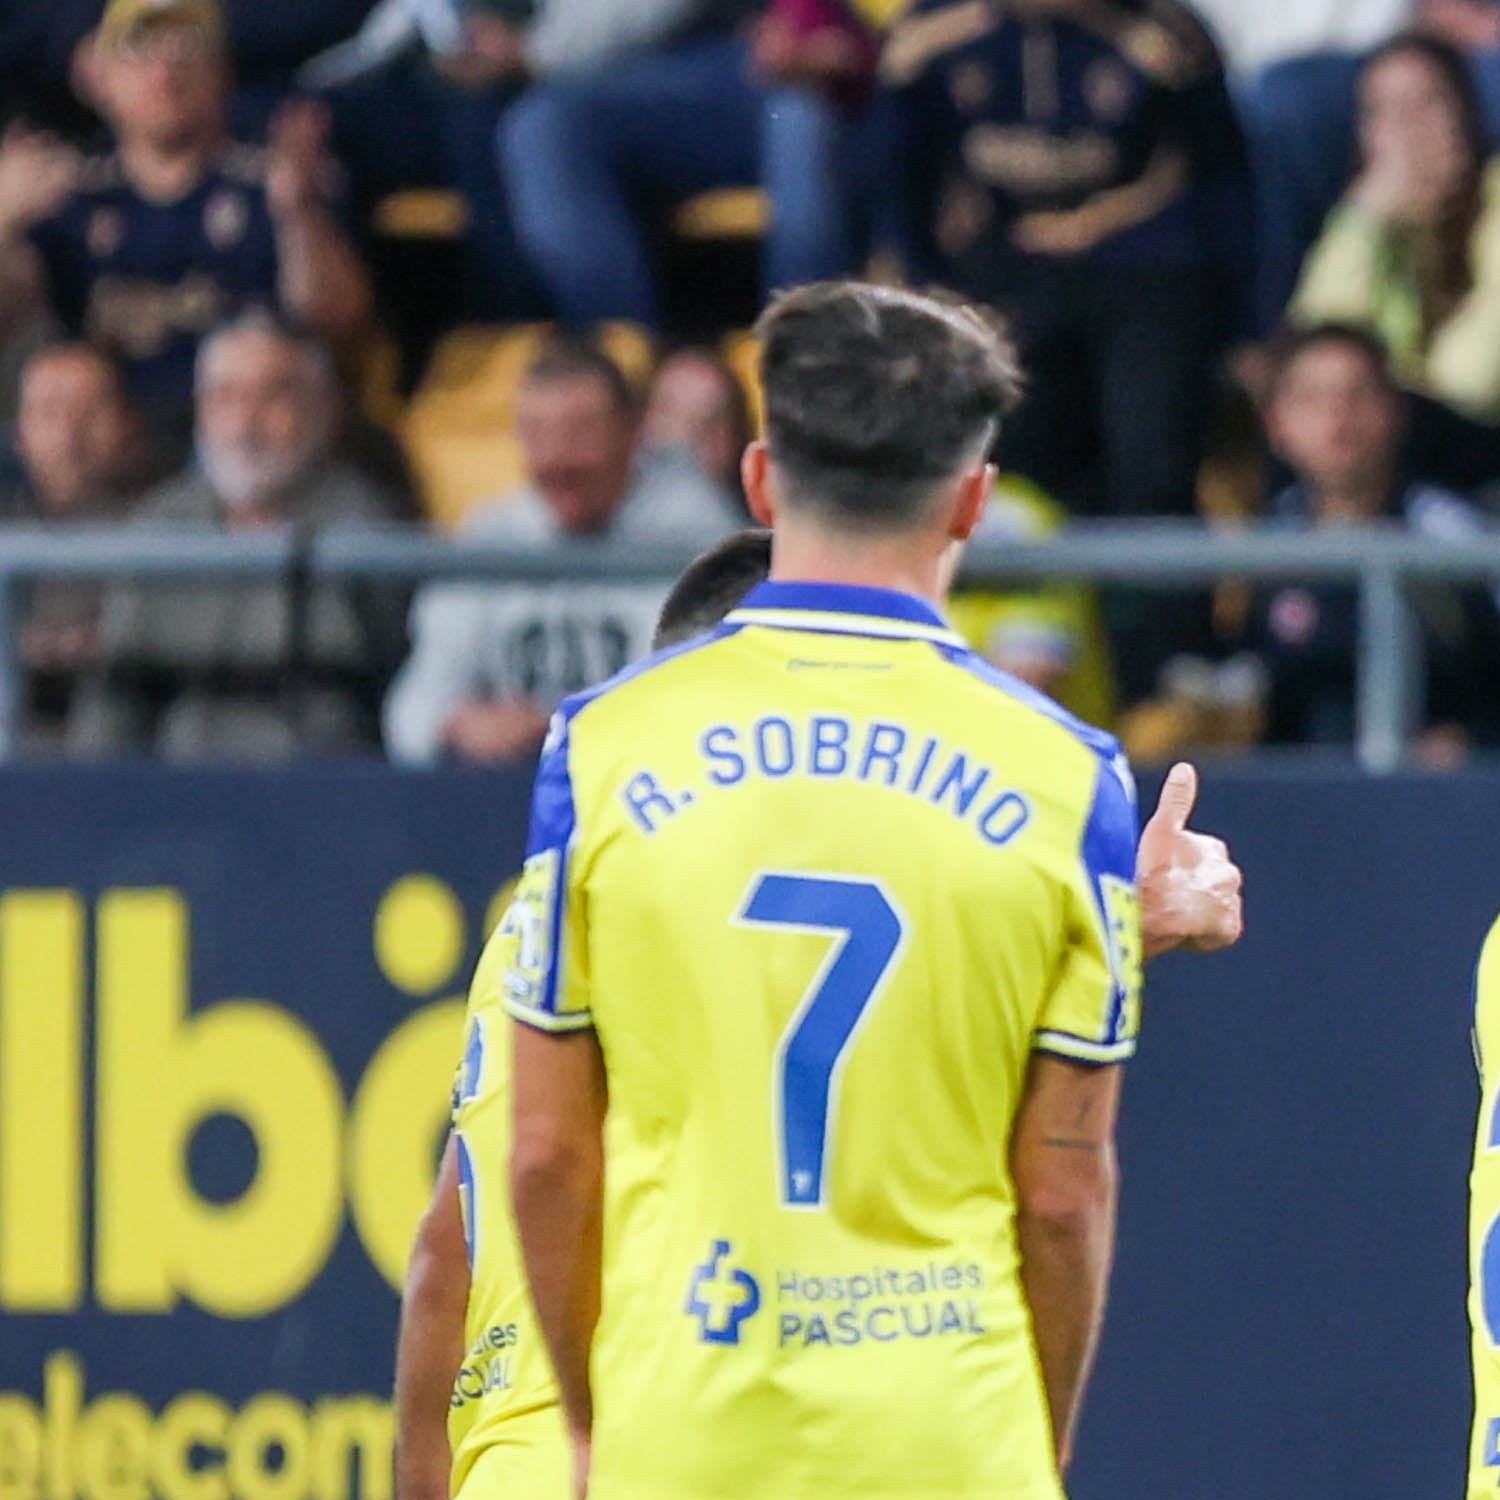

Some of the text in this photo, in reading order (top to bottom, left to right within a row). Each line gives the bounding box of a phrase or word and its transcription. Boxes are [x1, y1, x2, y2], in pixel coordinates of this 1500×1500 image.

[736, 872, 906, 1208] 7
[776, 1261, 984, 1312] Hospitales
[779, 1300, 987, 1350] PASCUAL
